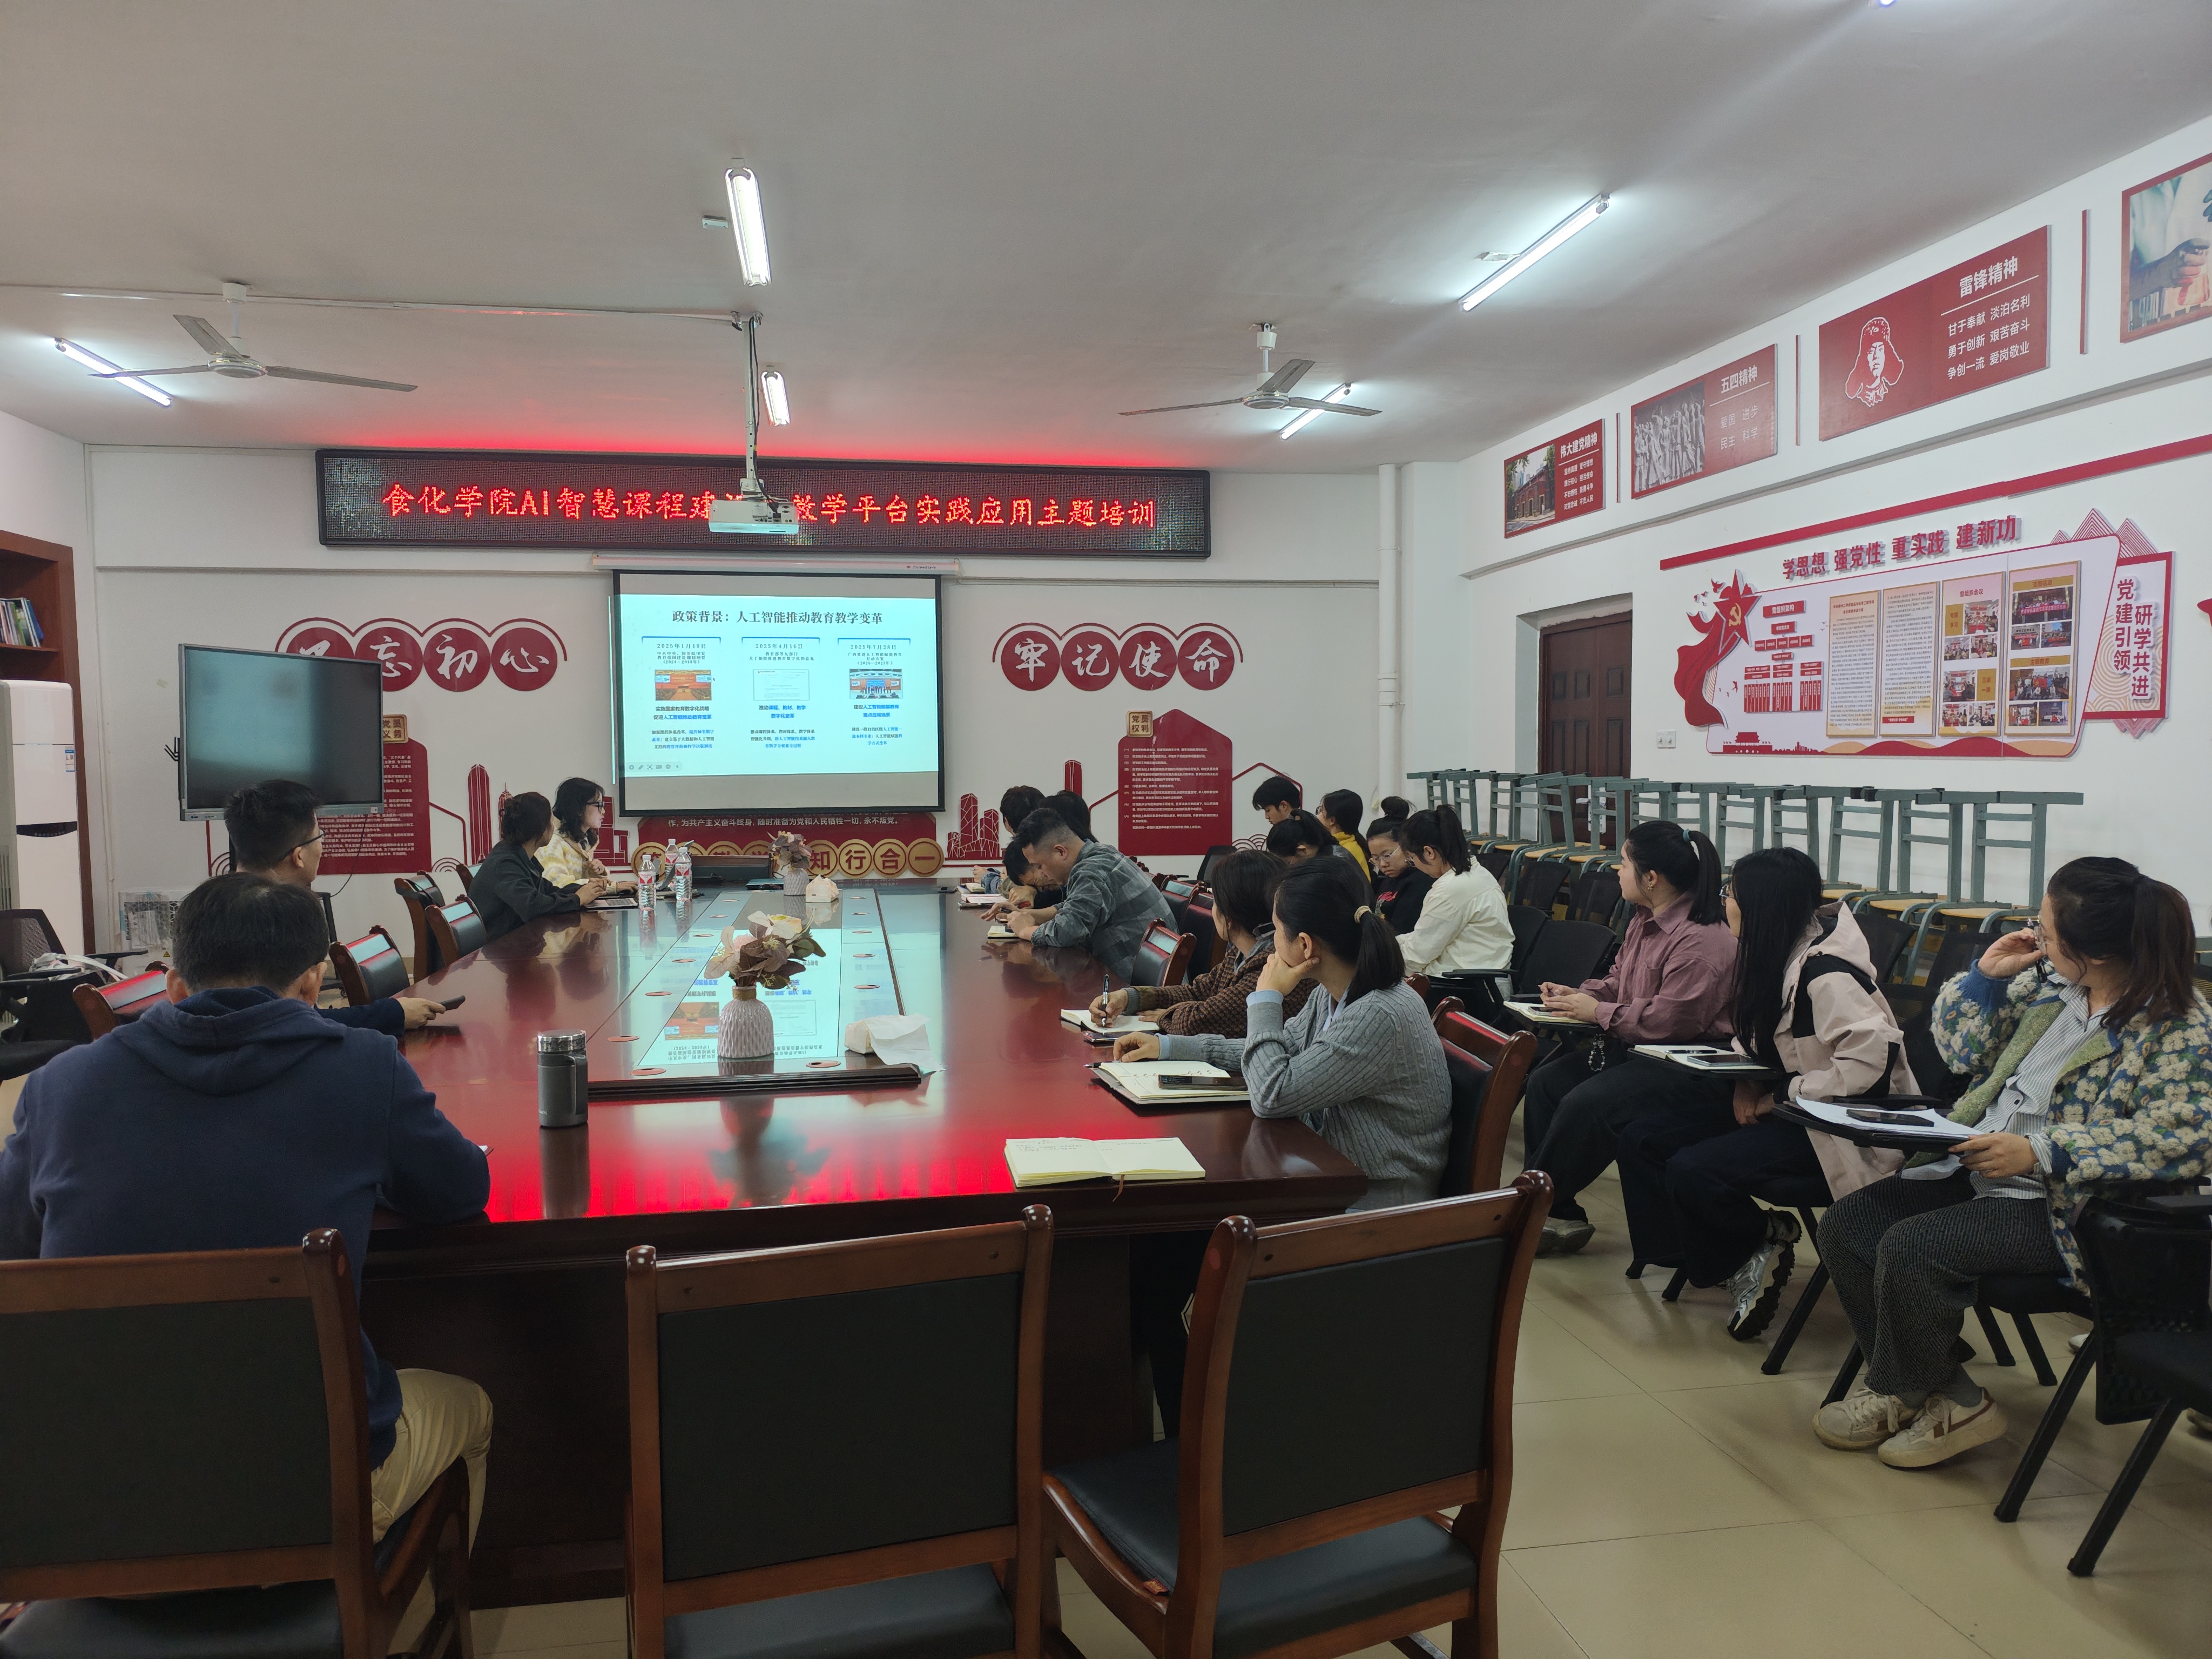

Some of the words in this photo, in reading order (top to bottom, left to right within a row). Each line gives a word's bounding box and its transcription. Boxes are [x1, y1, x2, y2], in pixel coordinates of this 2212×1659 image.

[1959, 255, 2018, 298] 雷锋精神
[1948, 311, 1986, 337] 甘于奉献
[1990, 293, 2030, 321] 淡泊名利
[1948, 333, 1986, 359] 勇于创新
[1990, 317, 2030, 343] 艰苦奋斗
[1947, 356, 1985, 380] 争创一流
[1989, 341, 2029, 366] 爱岗敬业
[1721, 365, 1758, 394] 五四精神
[1720, 413, 1736, 429] 爱国
[1742, 405, 1758, 421] 进步
[1560, 431, 1597, 458] 伟大建党精神
[1721, 434, 1736, 450] 民主
[1742, 426, 1758, 442] 科学
[382, 483, 1154, 528] 食化学院AI智慧课程建教学平台实践应用主题培训
[1579, 494, 1594, 506] 不负人民
[1782, 551, 1826, 579] 学思想
[1834, 541, 1881, 571] 强党性
[1891, 529, 1945, 560] 重实践
[1956, 515, 2017, 549] 建新功
[672, 610, 882, 624] 政策背景：人工智能推动教育教学变革
[2114, 578, 2134, 671] 党建引领
[1014, 638, 1228, 683] 牢记使命
[2132, 604, 2153, 697] 研学共进
[1131, 714, 1149, 723] 党员
[1131, 724, 1149, 733] 权利
[810, 848, 935, 870] 知行合一
